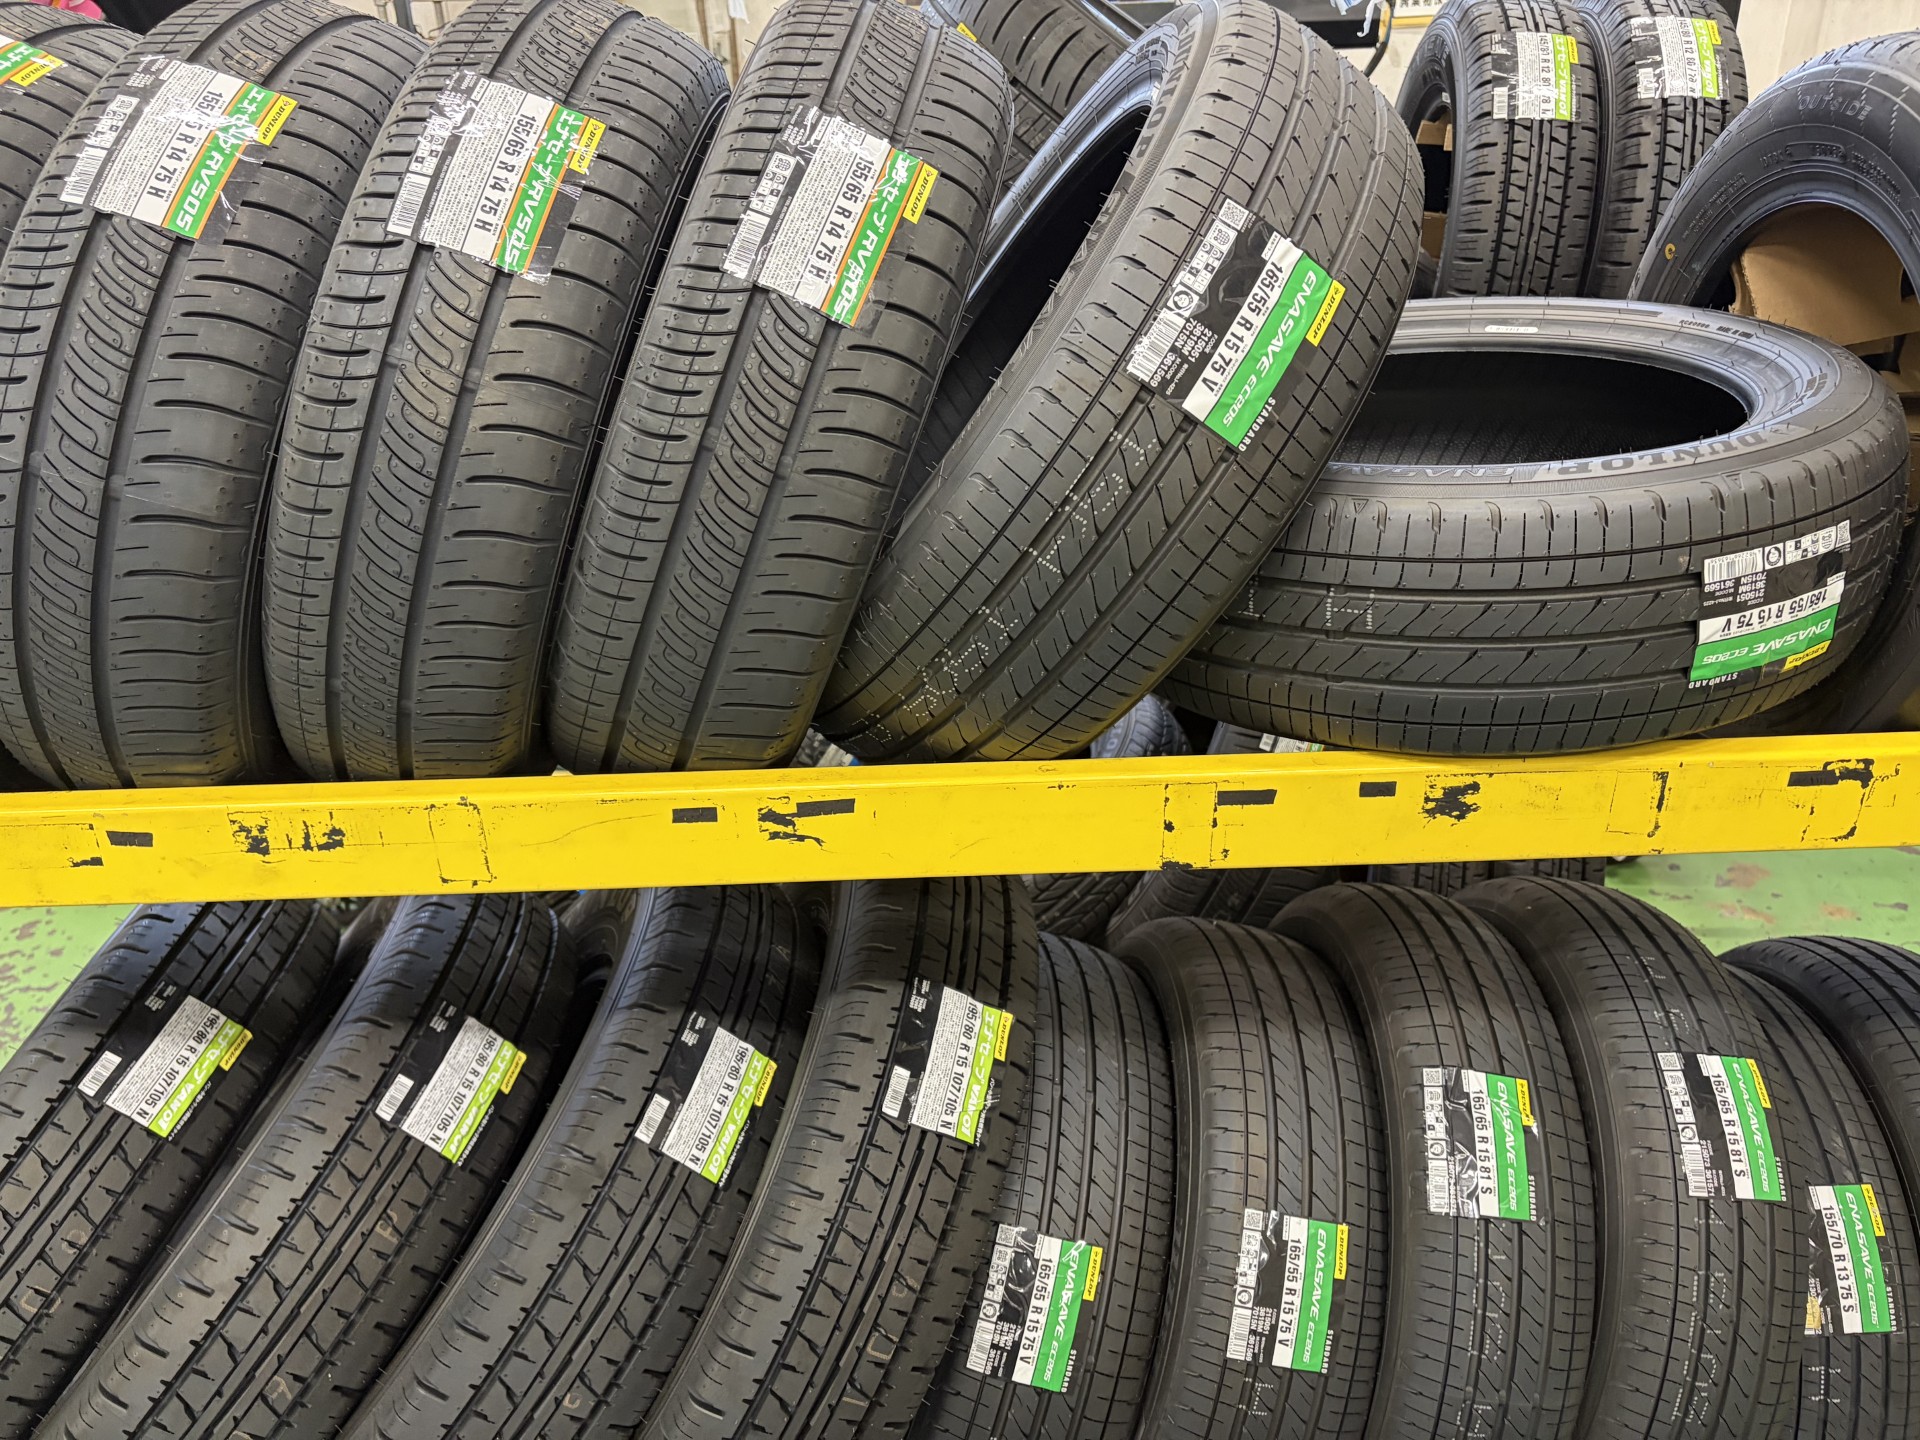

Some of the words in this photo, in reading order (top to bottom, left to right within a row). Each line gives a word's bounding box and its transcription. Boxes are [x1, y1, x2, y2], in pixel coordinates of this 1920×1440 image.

[1695, 20, 1712, 60] エナセーブ
[1555, 36, 1567, 79] エナセーブ
[1678, 19, 1690, 38] 145/80
[1684, 46, 1693, 55] 12
[1689, 86, 1695, 94] N
[1136, 31, 1195, 158] DUNLOP
[184, 86, 223, 134] 155/5
[260, 105, 285, 139] DUNLOP
[176, 129, 194, 148] R
[503, 111, 535, 158] 155/65
[575, 129, 595, 167] DUNLOP
[166, 141, 187, 165] 14
[496, 159, 515, 173] R
[154, 161, 176, 187] 75
[489, 173, 509, 193] 14
[840, 156, 873, 203] 155/65
[146, 182, 165, 203] H
[173, 150, 224, 231] RV505
[908, 176, 929, 217] DUNLOP
[479, 194, 501, 216] 75
[834, 205, 852, 219] R
[473, 217, 491, 232] H
[503, 180, 545, 265] RV505
[825, 218, 846, 239] 14
[814, 240, 836, 263] 75
[807, 263, 826, 280] H
[1245, 261, 1286, 316] 165/55
[1235, 314, 1254, 331] R
[1252, 269, 1319, 377] ENASAVE
[1309, 294, 1338, 339] DUNLOP
[1173, 317, 1196, 348] 7015N
[1180, 322, 1204, 355] 3819M
[1187, 328, 1212, 362] 215051
[1222, 329, 1245, 353] 15
[1148, 350, 1175, 388] 361569
[1164, 357, 1181, 379] M.CODE
[1209, 351, 1232, 375] 75
[1198, 375, 1218, 392] V
[1220, 373, 1259, 427] EC205
[1237, 396, 1276, 452] STANDARD
[1558, 432, 1769, 475] DUNLOP
[1703, 578, 1735, 592] 361569
[1738, 579, 1766, 593] 3819M
[1739, 570, 1767, 584] 7015N
[1735, 588, 1765, 602] 215051
[1786, 588, 1829, 615] 165/55
[1734, 611, 1757, 629] 75
[1756, 607, 1774, 623] 15
[1774, 603, 1787, 617] R
[1719, 617, 1733, 632] V
[1700, 646, 1749, 664] EC205
[1747, 618, 1832, 656] ENASAVE
[1689, 672, 1738, 689] STANDARD
[191, 1010, 220, 1045] 195/80
[962, 1002, 978, 1039] 195/80
[184, 1043, 197, 1055] R
[473, 1034, 497, 1067] 195/80
[959, 1042, 970, 1051] R
[973, 1011, 995, 1083] エナセーブ
[996, 1022, 1007, 1056] DUNLOP
[175, 1052, 190, 1067] 15
[190, 1023, 236, 1083] エナセーブ
[727, 1044, 749, 1080] 195/80
[956, 1054, 968, 1067] 15
[460, 1077, 474, 1090] 15
[468, 1067, 480, 1077] R
[477, 1045, 512, 1104] エナセーブ
[754, 1069, 771, 1102] DUNLOP
[144, 1066, 180, 1108] 107/105
[715, 1092, 729, 1106] 15
[722, 1082, 734, 1092] R
[731, 1055, 763, 1123] エナセーブ
[944, 1071, 964, 1116] 107/105
[1711, 1072, 1732, 1114] 165/65
[136, 1107, 149, 1119] N
[155, 1080, 195, 1130] VAN01
[436, 1090, 466, 1133] 107/105
[960, 1084, 981, 1136] VAN01
[1472, 1089, 1487, 1130] 165/65
[694, 1107, 722, 1152] 107/105
[940, 1120, 951, 1129] N
[1723, 1118, 1735, 1128] R
[1732, 1061, 1764, 1149] ENASAVE
[1755, 1149, 1770, 1193] EC205
[429, 1133, 442, 1144] N
[1477, 1135, 1488, 1144] R
[1497, 1081, 1516, 1167] ENASAVE
[1507, 1167, 1516, 1211] EC205
[1726, 1130, 1739, 1145] 15
[688, 1153, 701, 1165] N
[1478, 1148, 1489, 1161] 15
[1699, 1139, 1710, 1167] 215073
[1730, 1147, 1743, 1163] 81
[1479, 1166, 1491, 1179] 81
[1704, 1168, 1715, 1196] 361571
[1733, 1167, 1746, 1179] S
[1774, 1156, 1787, 1201] STANDARD
[1480, 1186, 1491, 1194] S
[1528, 1175, 1536, 1220] STANDARD
[1822, 1204, 1843, 1249] 155/70
[1286, 1237, 1301, 1282] 165/55
[1834, 1252, 1845, 1262] R
[1844, 1190, 1874, 1282] ENASAVE
[1866, 1282, 1879, 1326] EC205
[1033, 1257, 1052, 1301] 165/55
[1086, 1259, 1098, 1296] DUNLOP
[1309, 1228, 1327, 1320] ENASAVE
[1836, 1265, 1848, 1280] 13
[1284, 1287, 1296, 1296] R
[1839, 1284, 1852, 1300] 75
[1030, 1305, 1042, 1314] R
[1250, 1306, 1259, 1329] 7015N
[1256, 1306, 1265, 1332] 3819M
[1282, 1299, 1294, 1314] 15
[1842, 1303, 1854, 1313] S
[1885, 1286, 1897, 1331] STANDARD
[1026, 1318, 1039, 1332] 15
[1262, 1307, 1271, 1334] 215051
[1279, 1318, 1292, 1333] 75
[1004, 1323, 1015, 1350] 215051
[1022, 1335, 1035, 1350] 75
[1245, 1334, 1255, 1361] 361569
[1277, 1337, 1289, 1347] V
[1302, 1321, 1314, 1363] EC205
[1018, 1355, 1030, 1364] V
[1043, 1340, 1058, 1382] EC205
[1321, 1329, 1333, 1374] STANDARD
[1060, 1349, 1076, 1392] STANDARD
